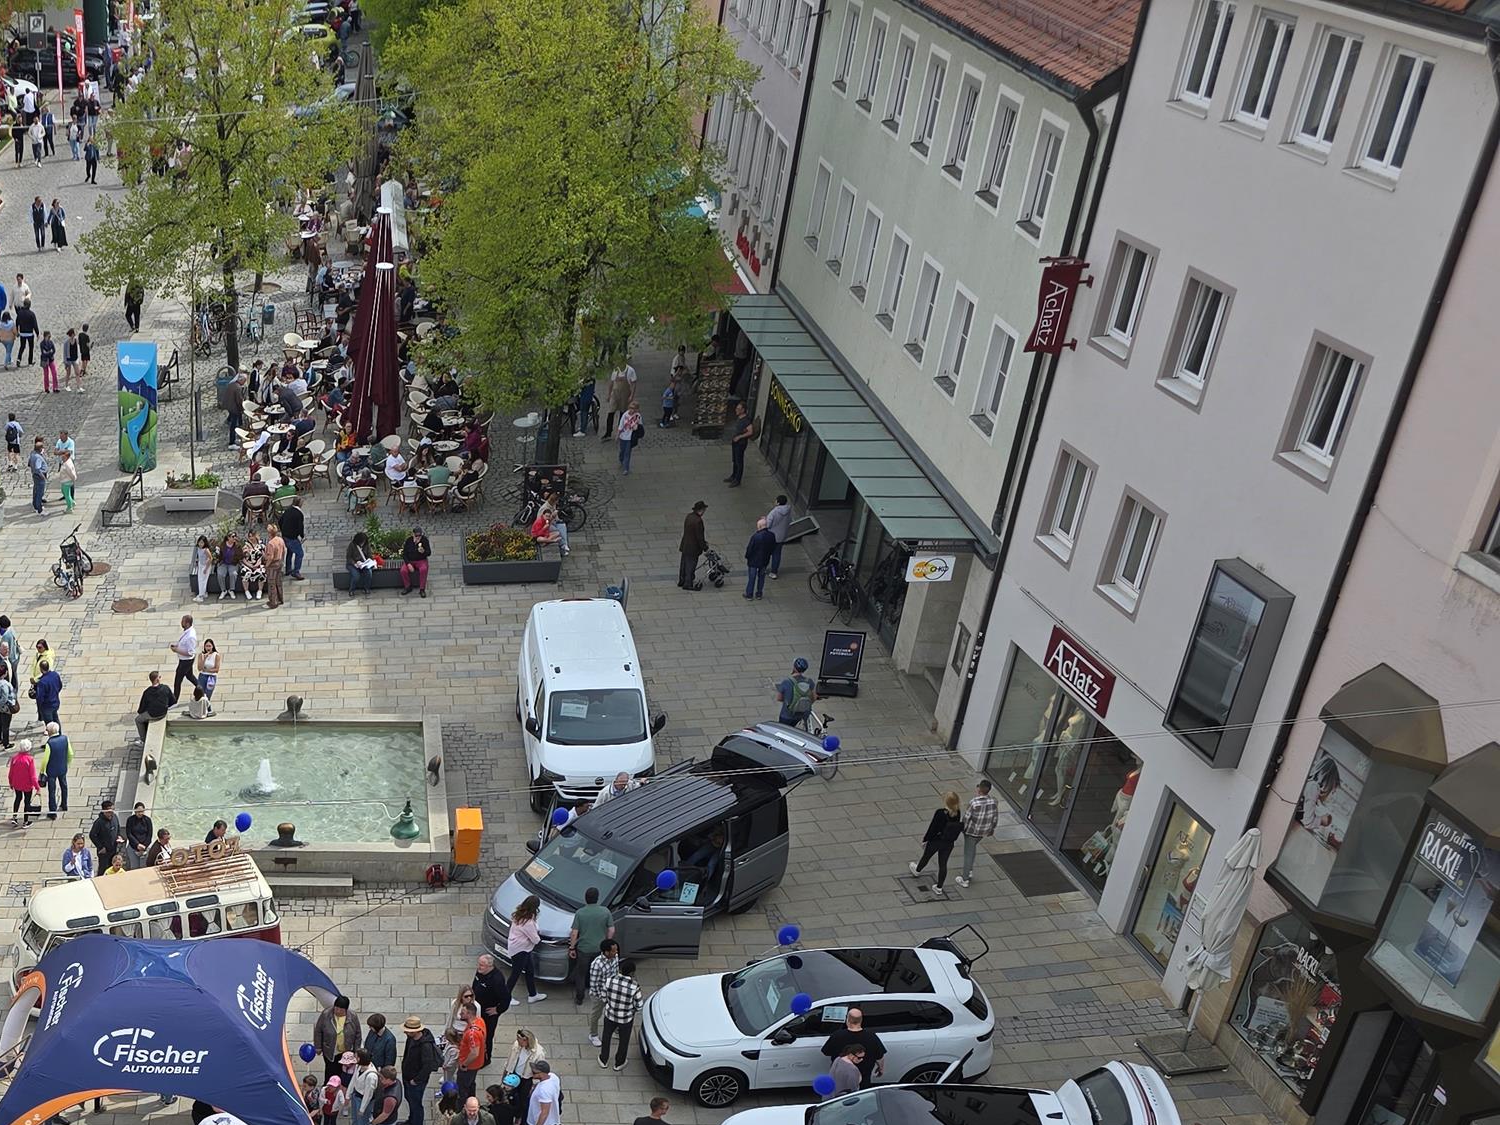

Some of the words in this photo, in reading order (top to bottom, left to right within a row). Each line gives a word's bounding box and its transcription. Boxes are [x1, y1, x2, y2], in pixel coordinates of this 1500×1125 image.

[1035, 280, 1069, 346] Achatz
[1047, 640, 1102, 703] Achatz
[1433, 820, 1451, 839] 100
[53, 974, 72, 1026] Fischer
[251, 963, 270, 1024] Fischer
[113, 1044, 209, 1064] Fischer
[121, 1064, 200, 1075] AUTOMOBILE
